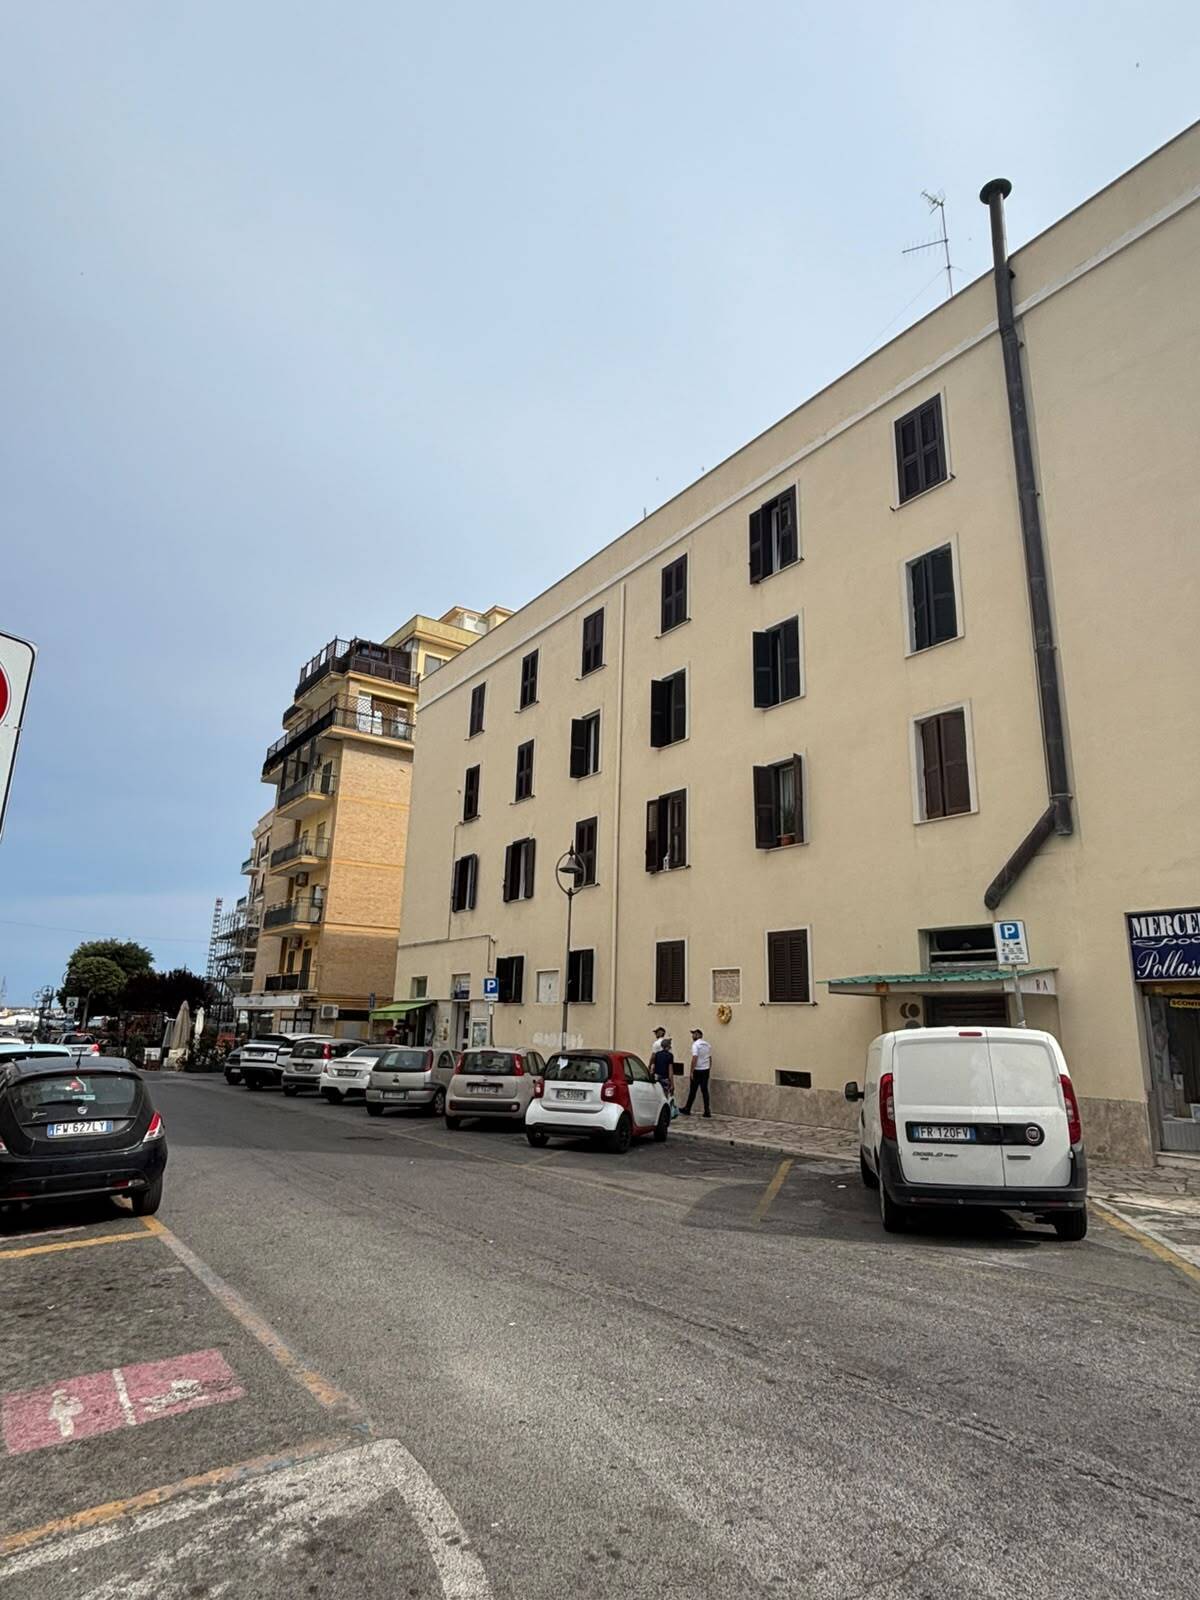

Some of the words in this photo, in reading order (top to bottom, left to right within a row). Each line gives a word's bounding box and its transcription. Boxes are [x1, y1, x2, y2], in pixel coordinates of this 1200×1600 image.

[1131, 912, 1200, 938] MERCE
[1003, 925, 1016, 939] P
[487, 980, 497, 992] P
[920, 1126, 934, 1137] FR
[938, 1126, 970, 1138] 120FV
